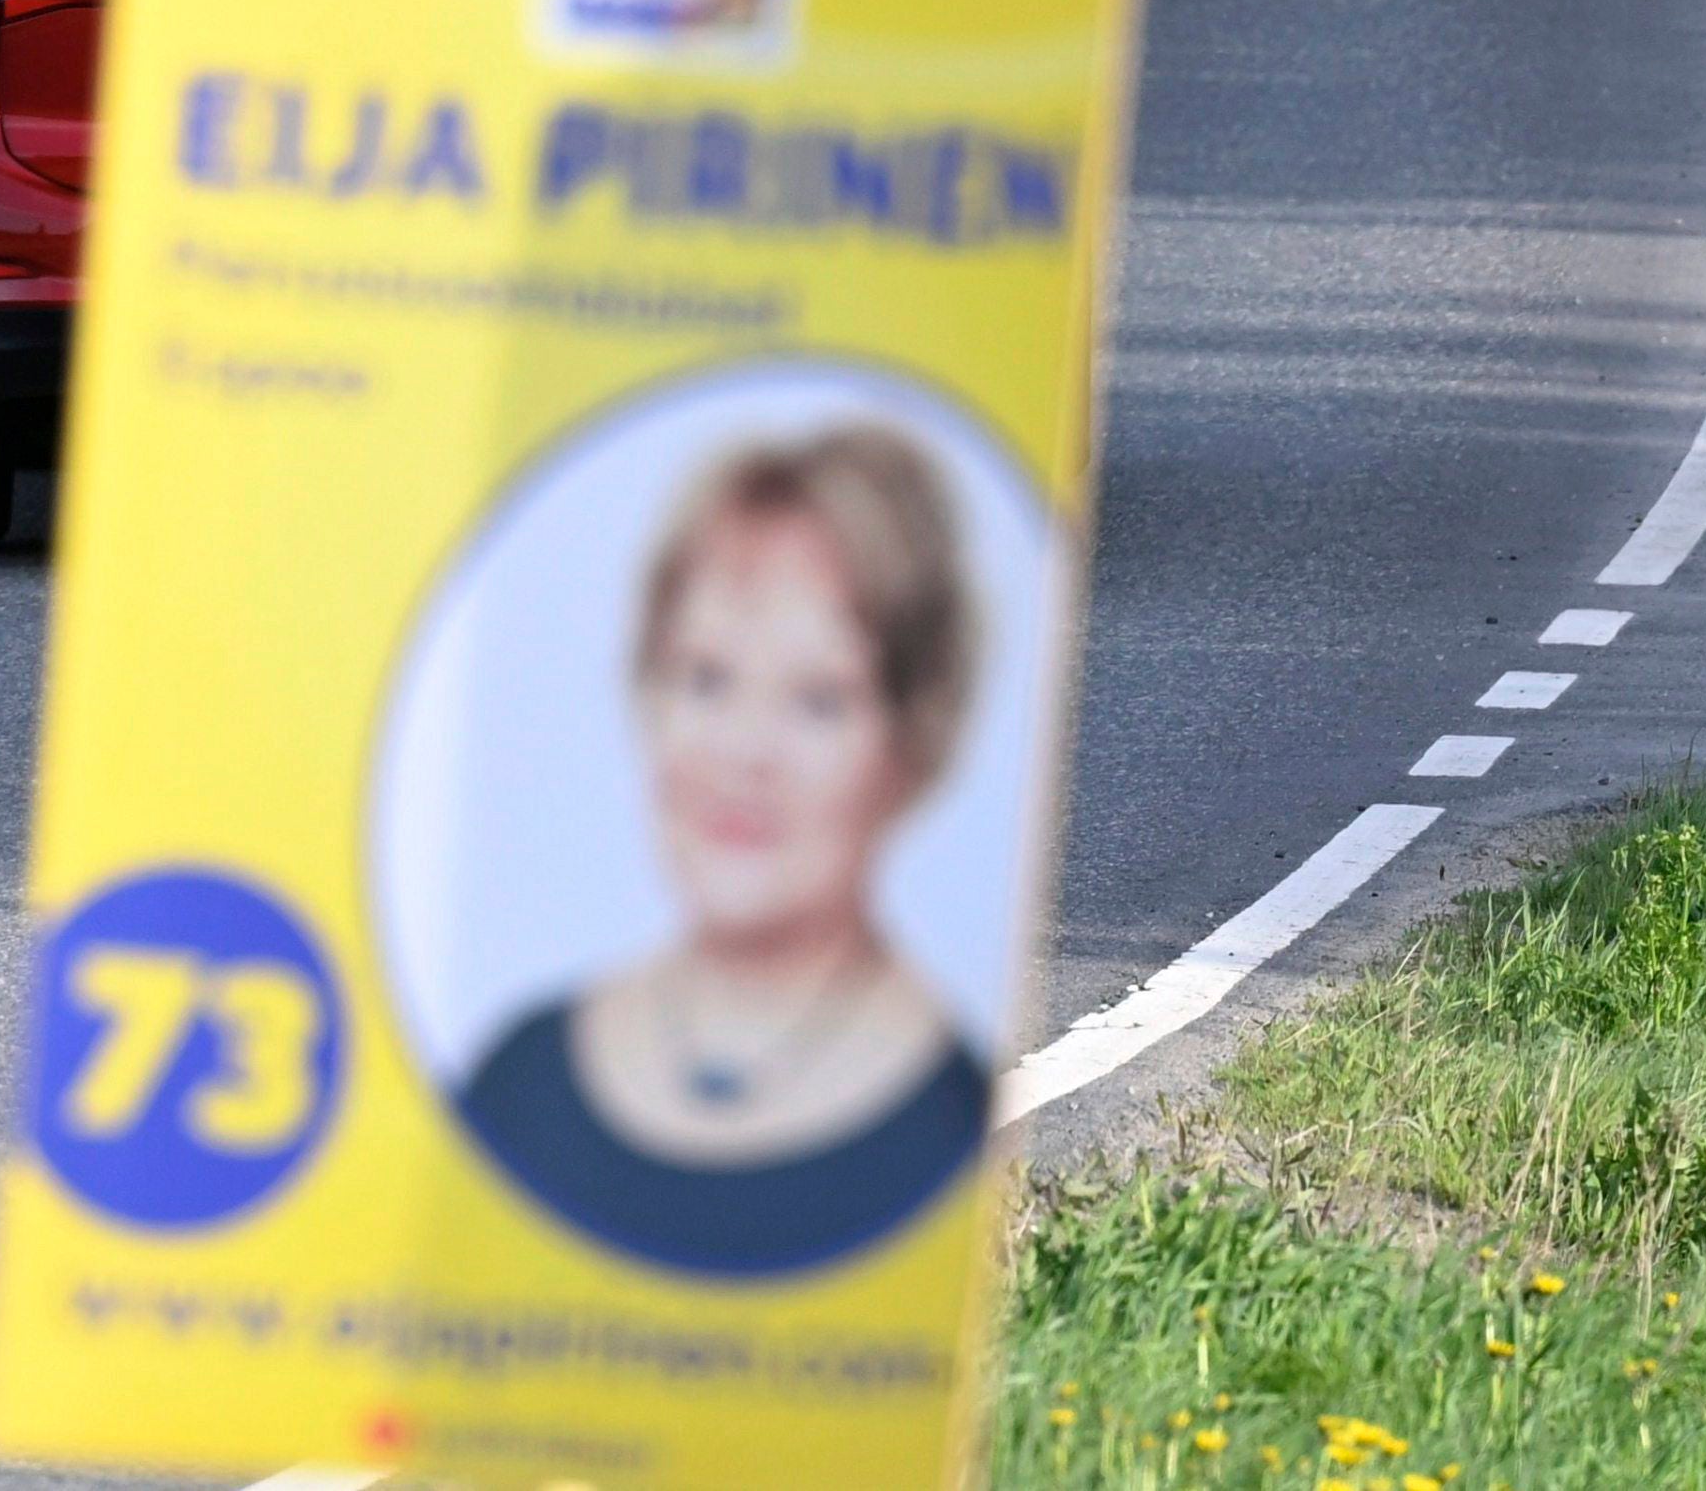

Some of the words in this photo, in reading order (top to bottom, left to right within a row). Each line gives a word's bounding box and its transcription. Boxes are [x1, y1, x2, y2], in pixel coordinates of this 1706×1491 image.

[175, 70, 486, 203] EIJA
[537, 100, 1071, 252] PIRINEN
[63, 942, 325, 1156] 73
